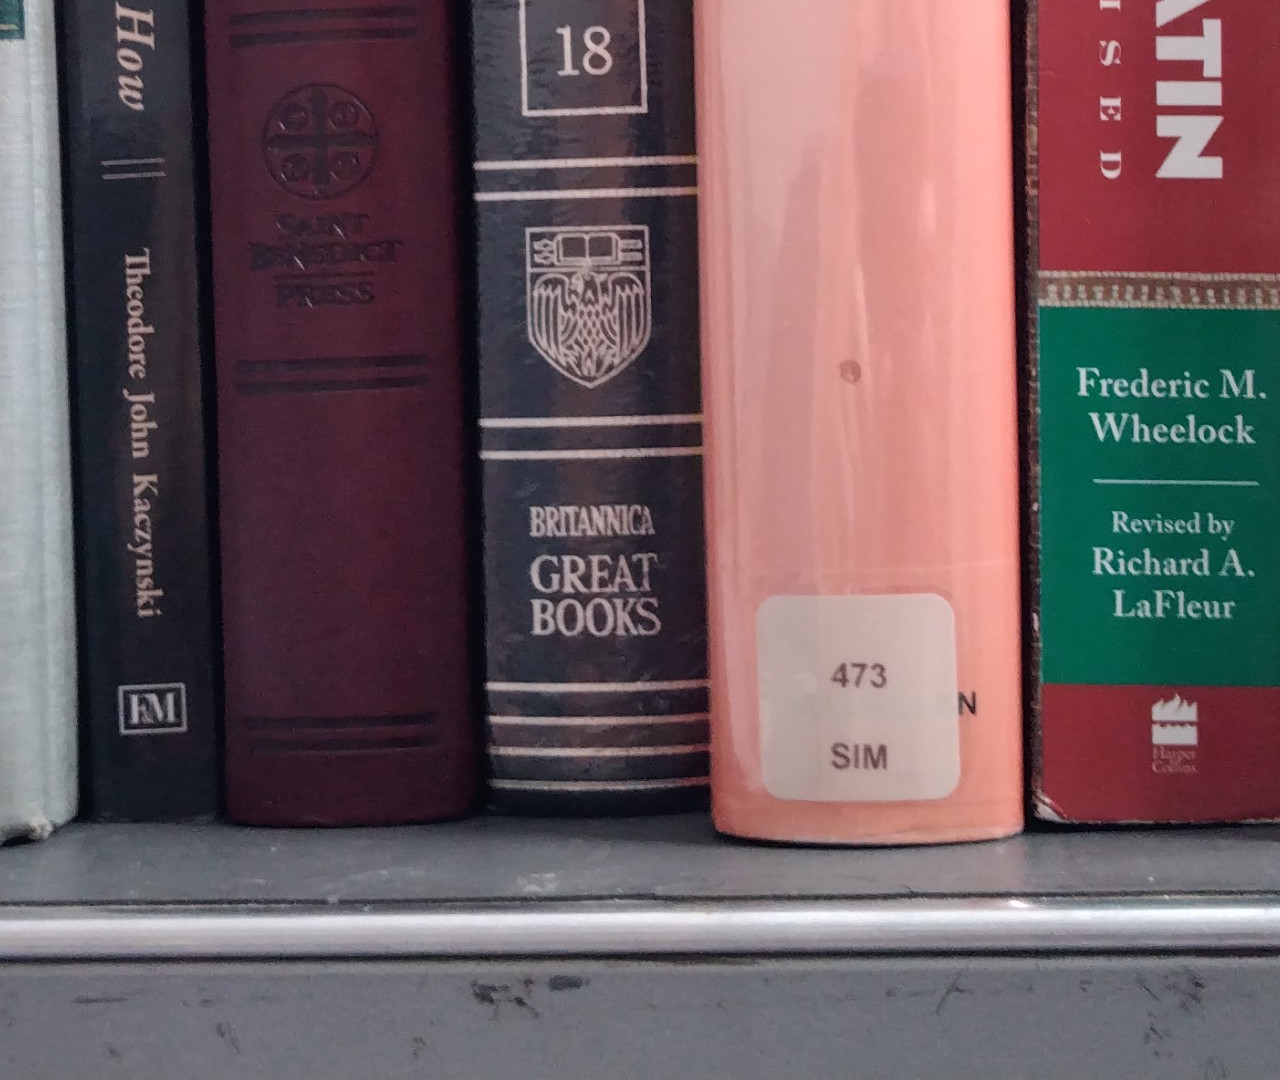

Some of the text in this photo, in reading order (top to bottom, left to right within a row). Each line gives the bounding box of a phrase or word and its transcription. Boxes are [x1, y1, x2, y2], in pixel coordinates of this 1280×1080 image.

[115, 1, 155, 111] How
[555, 25, 614, 77] 18
[1076, 366, 1267, 400] Frederic M.
[122, 247, 164, 618] Theodore John Kaczynski
[1088, 411, 1256, 445] Wheelock
[529, 504, 655, 537] BRITANNICA
[1111, 510, 1235, 542] Revised by
[529, 553, 659, 594] GREAT
[1092, 546, 1255, 578] Richard A.
[530, 597, 662, 636] BOOKS
[1112, 589, 1236, 619] LaFleur
[830, 662, 888, 688] 473
[830, 742, 888, 770] SIM
